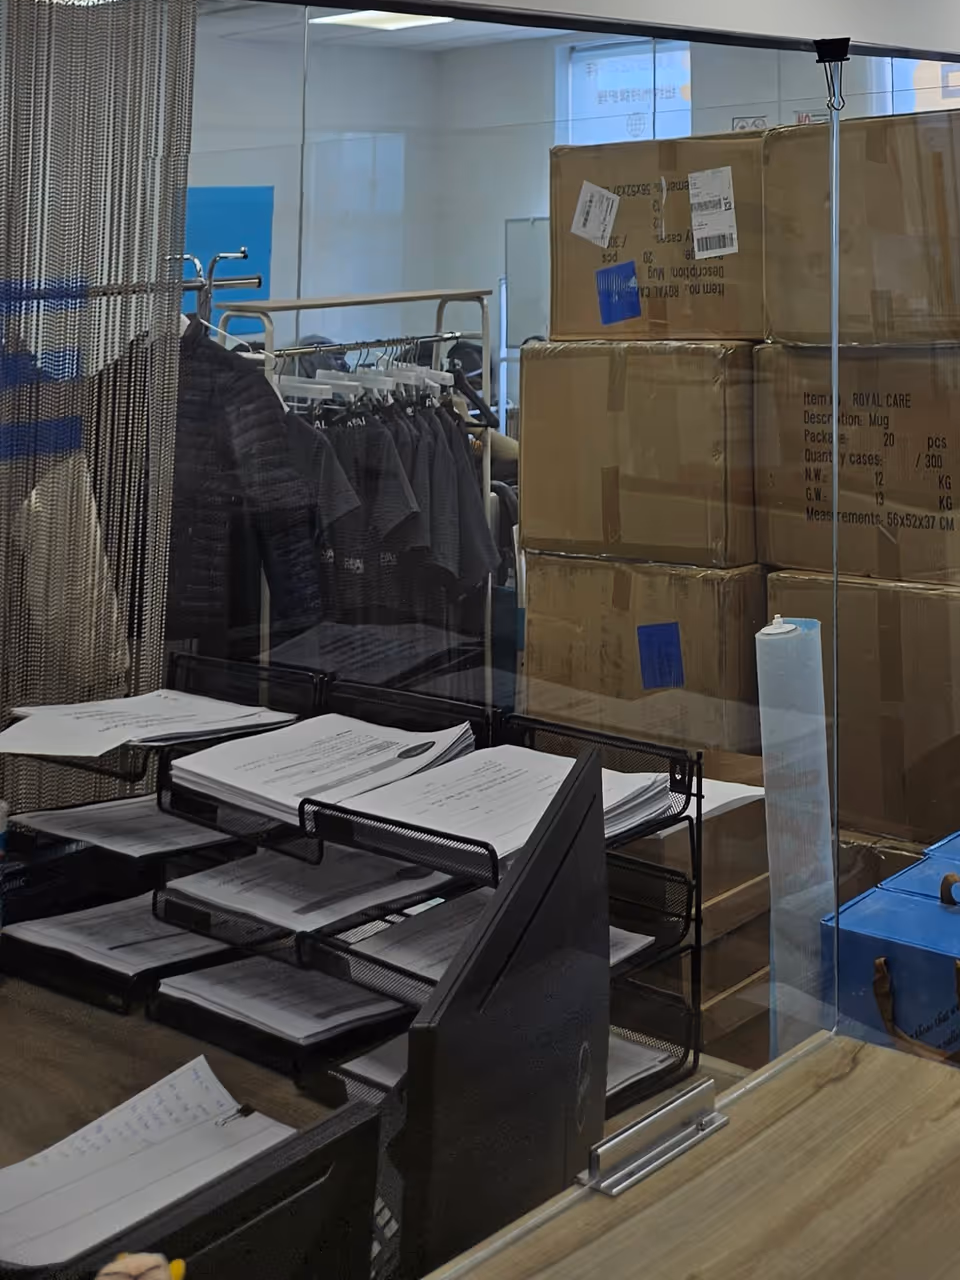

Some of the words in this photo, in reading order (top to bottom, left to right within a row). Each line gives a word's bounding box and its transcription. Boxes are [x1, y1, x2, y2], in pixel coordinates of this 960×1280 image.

[601, 251, 618, 264] pcs
[647, 265, 665, 280] Mug
[638, 285, 651, 298] CA
[655, 284, 679, 298] ROYAL
[705, 283, 724, 297] Item
[803, 392, 827, 407] Item
[852, 392, 883, 408] ROYAL
[886, 393, 911, 409] CARE
[869, 412, 889, 429] Mug
[883, 432, 895, 447] 20
[927, 436, 947, 451] pcs
[925, 454, 943, 469] 300
[874, 471, 884, 486] 12
[938, 475, 952, 490] KG
[875, 492, 884, 506] 13
[939, 495, 952, 511] KG
[887, 512, 936, 530] 56x52x37
[939, 515, 955, 532] CM
